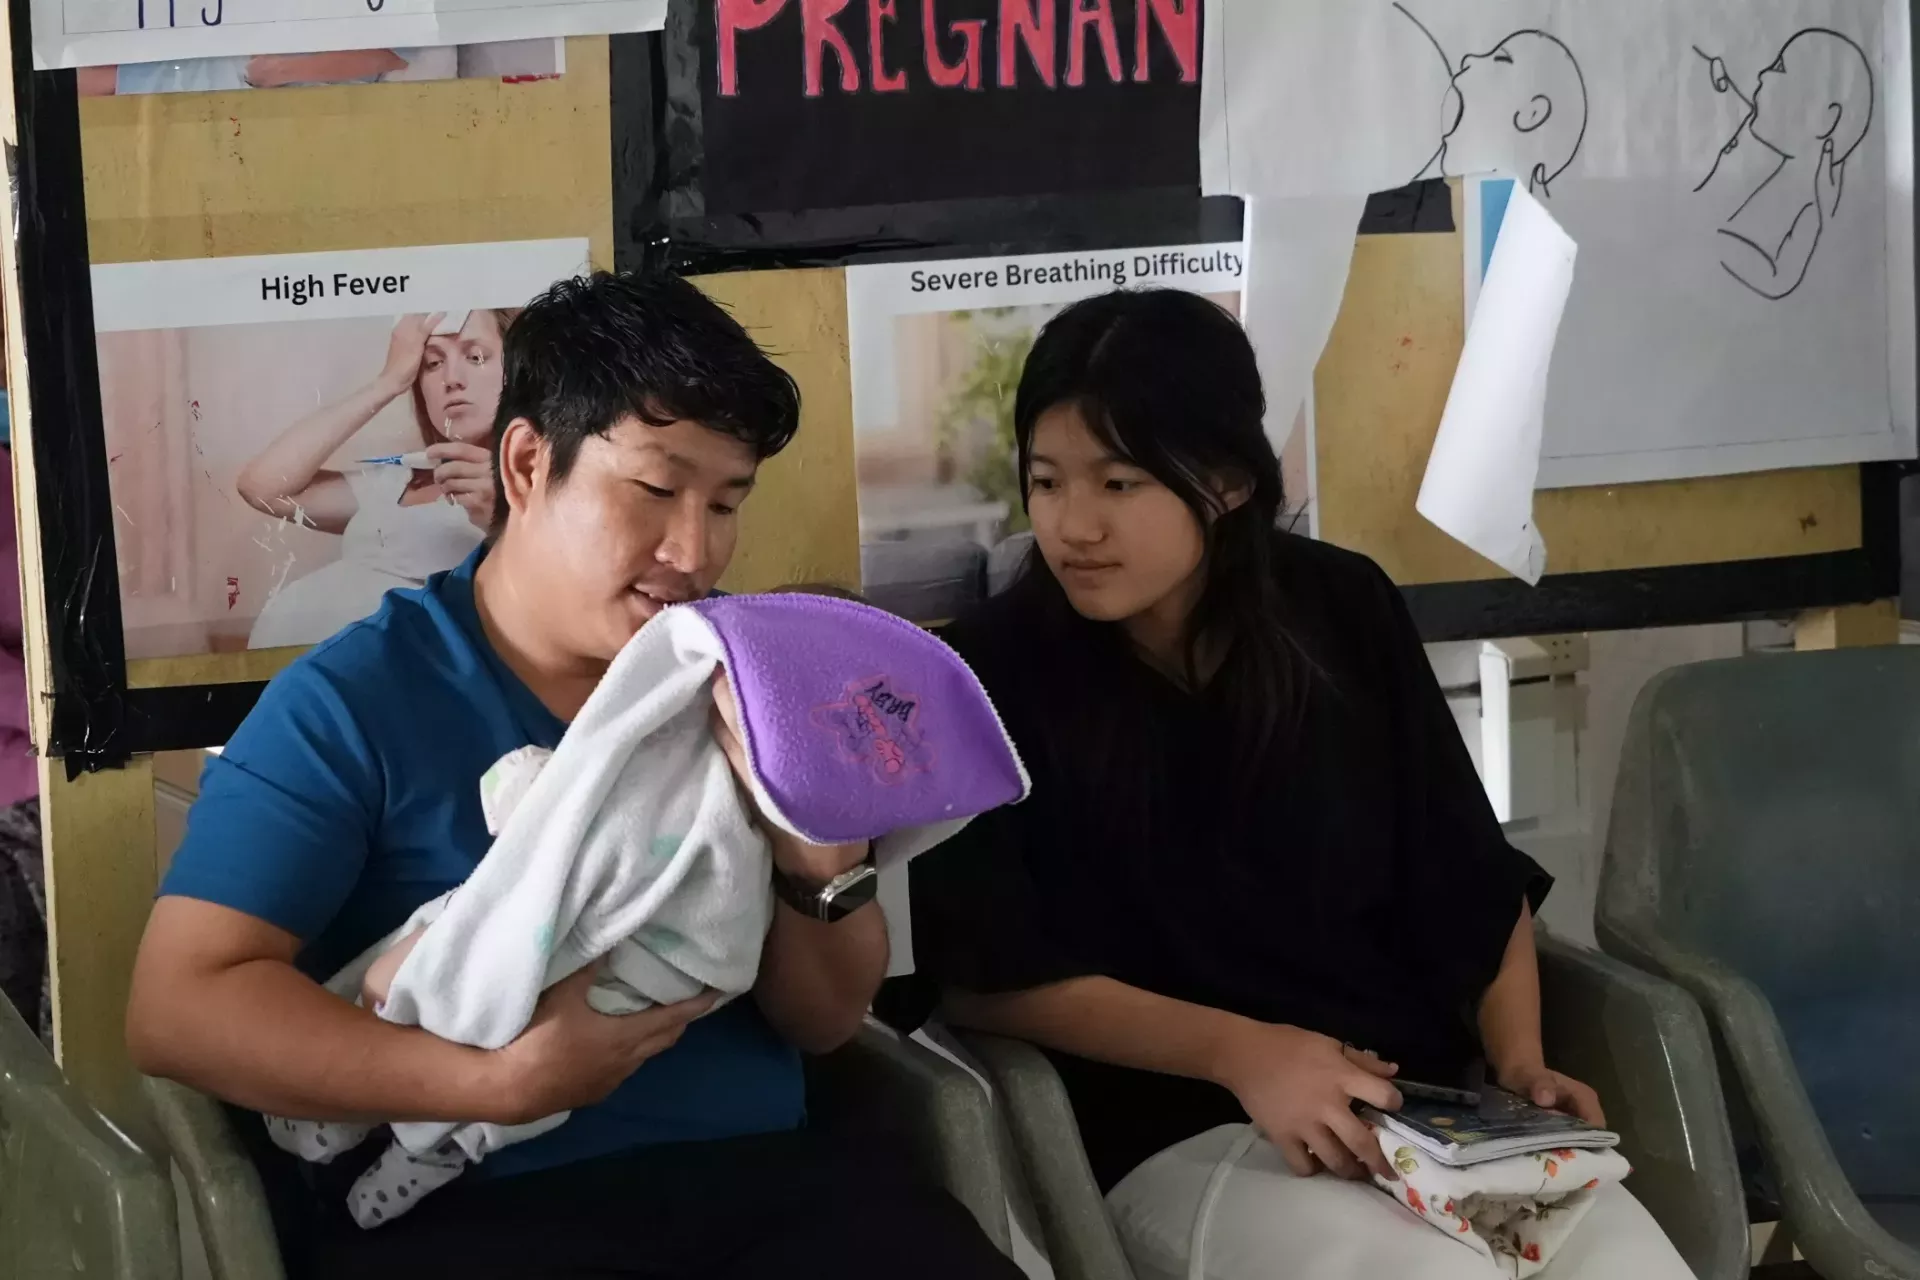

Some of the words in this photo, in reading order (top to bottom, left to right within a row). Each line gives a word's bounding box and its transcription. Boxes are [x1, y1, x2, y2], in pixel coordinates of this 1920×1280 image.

[716, 0, 1199, 97] PREGNAN
[261, 273, 325, 306] High
[333, 273, 410, 297] Fever
[910, 270, 998, 292] Severe
[1005, 258, 1127, 285] Breathing
[1133, 249, 1243, 277] Difficulty
[863, 681, 916, 723] BABY
